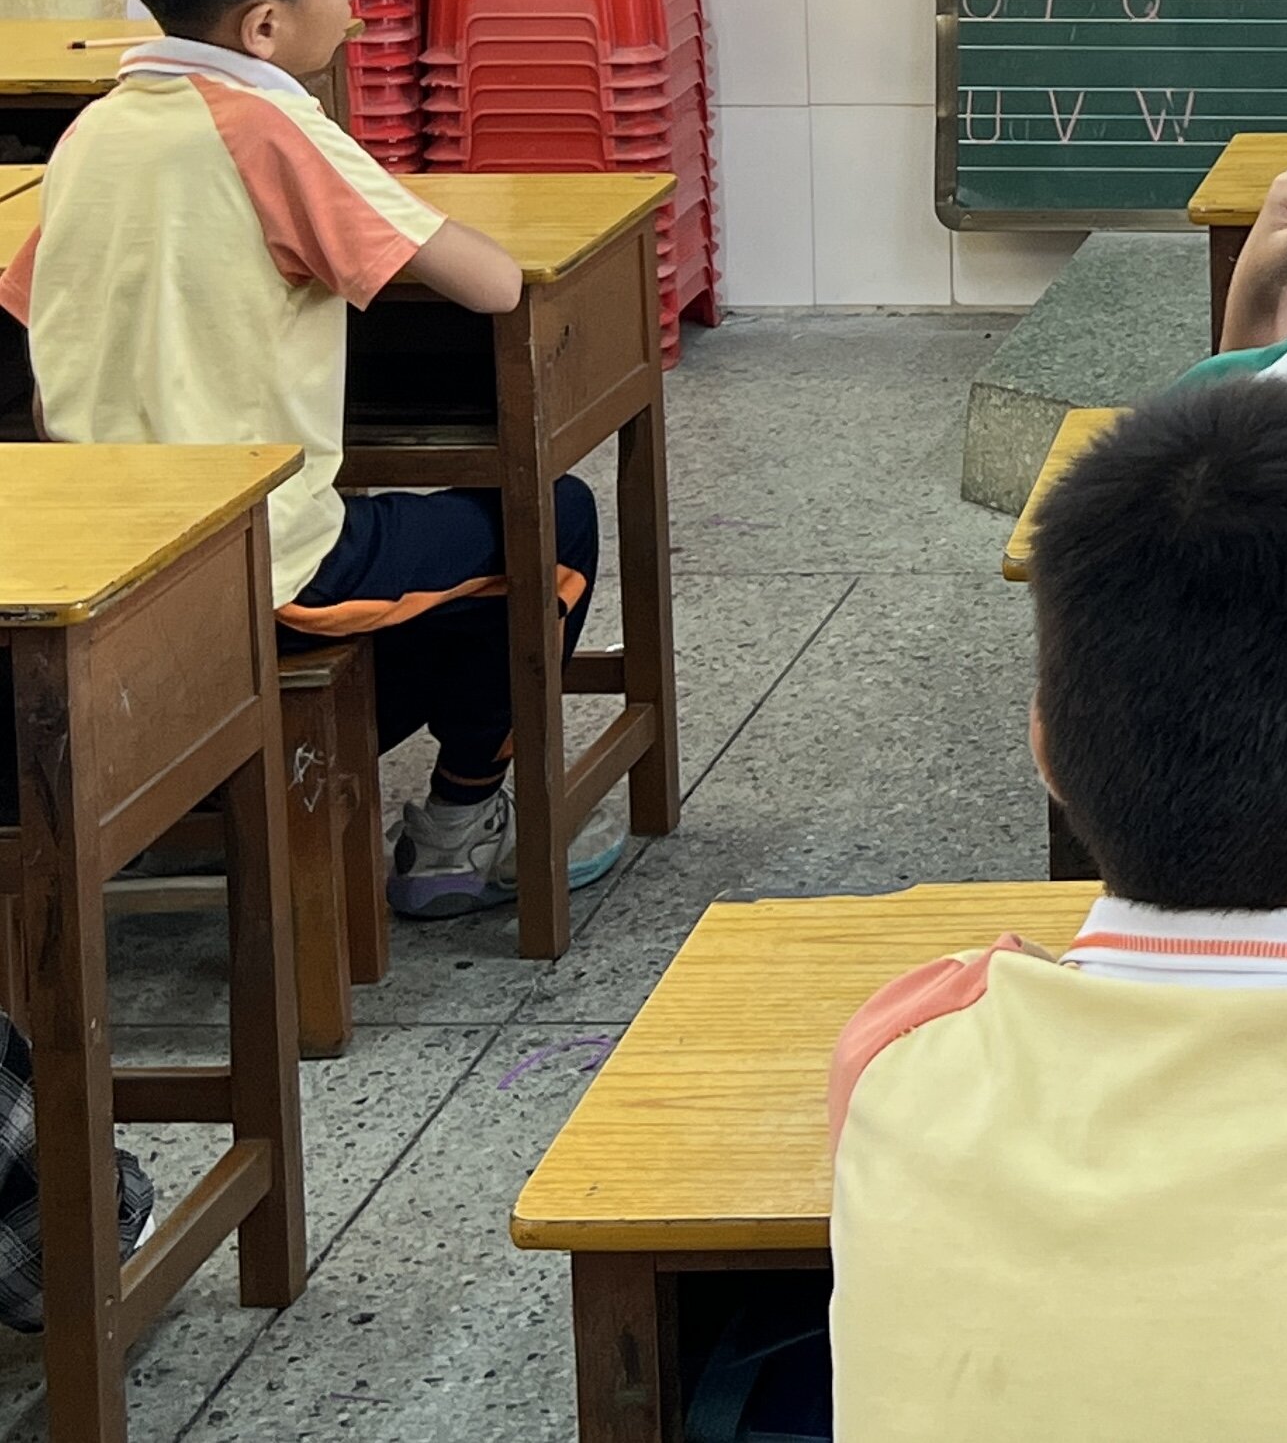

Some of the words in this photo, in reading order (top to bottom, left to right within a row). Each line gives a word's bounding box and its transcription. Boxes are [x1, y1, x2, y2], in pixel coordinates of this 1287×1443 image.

[966, 90, 1001, 143] U
[1049, 90, 1085, 143] V
[1136, 90, 1194, 143] W
